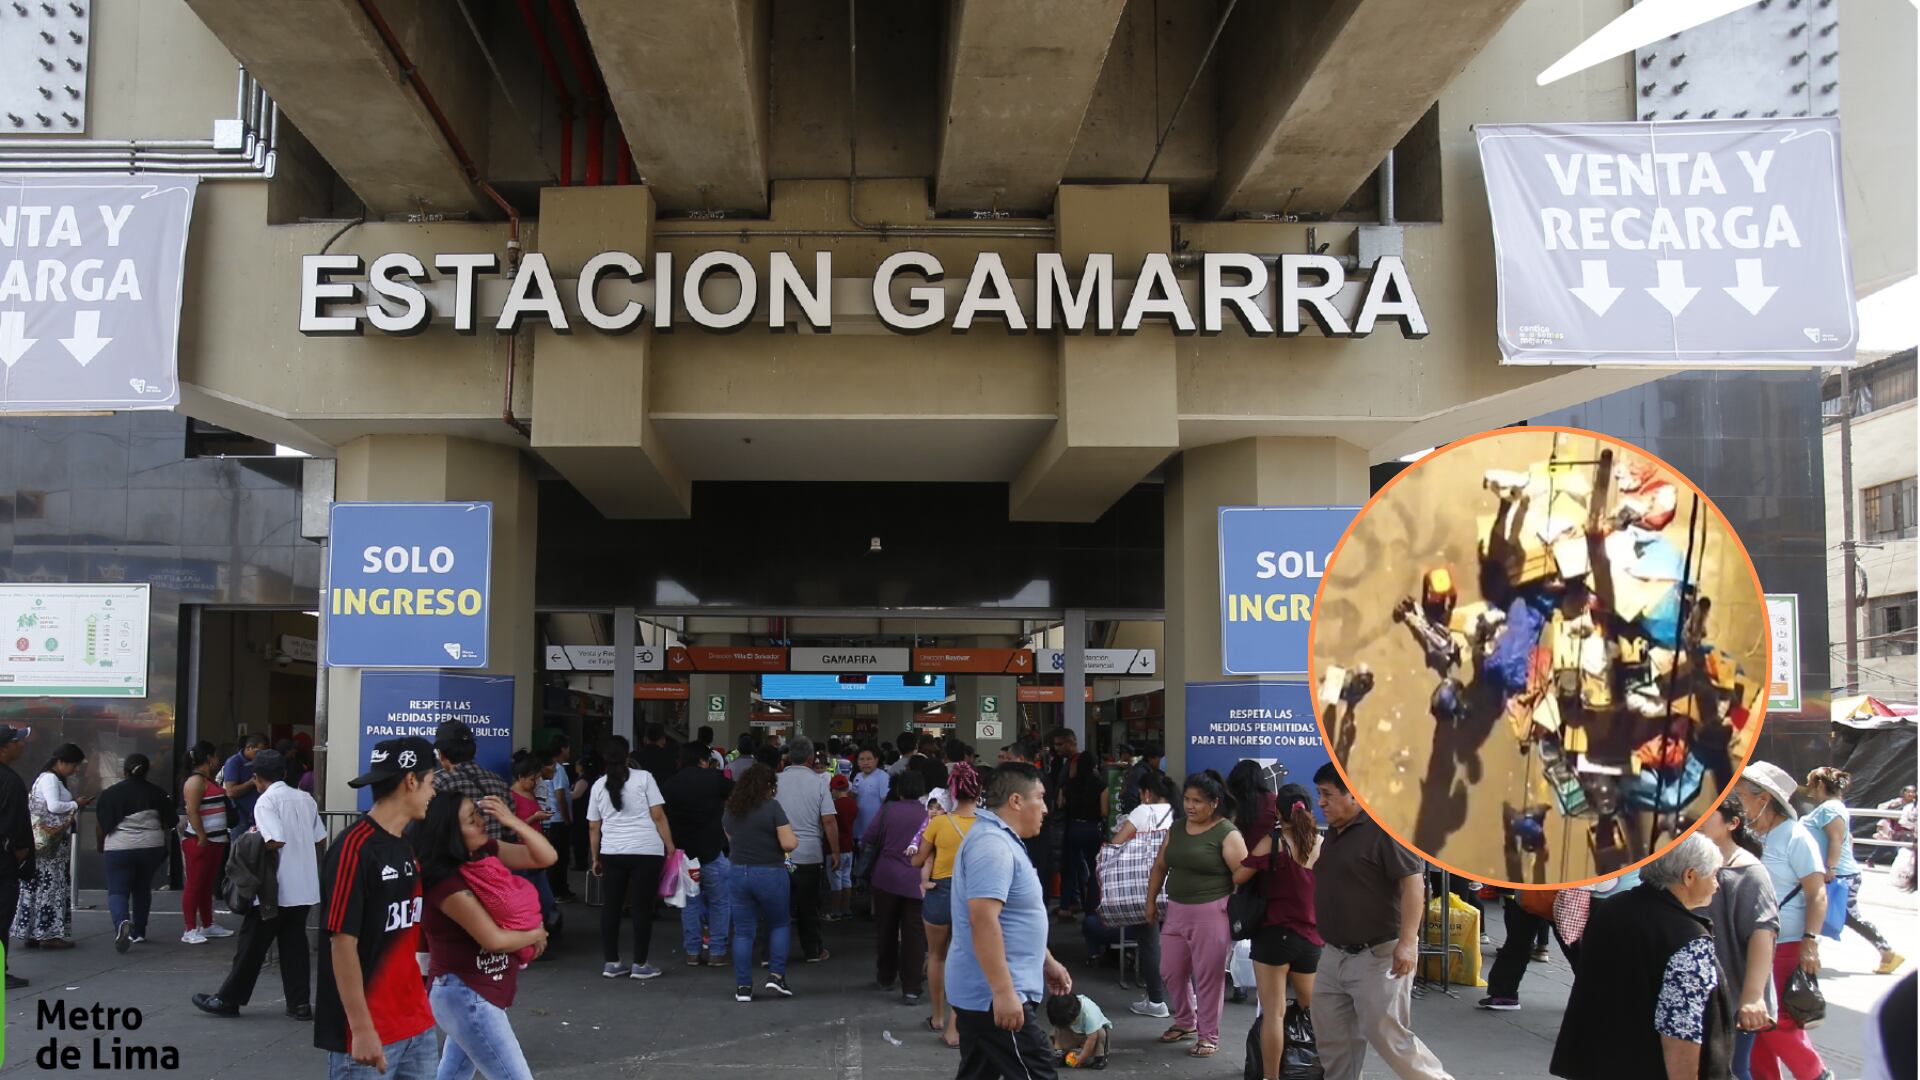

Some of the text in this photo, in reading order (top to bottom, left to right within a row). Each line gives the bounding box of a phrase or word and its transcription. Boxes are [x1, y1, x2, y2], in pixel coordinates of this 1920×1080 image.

[1544, 150, 1775, 196] VENTA Y
[99, 205, 135, 247] Y
[1540, 204, 1801, 251] RECARGA
[299, 250, 1431, 338] ESTACION GAMARRA
[362, 545, 455, 574] SOLO
[332, 588, 483, 617] INGRESO
[1228, 593, 1317, 622] INGR
[821, 655, 878, 665] GAMARRA
[410, 700, 471, 711] RESPETA LAS
[711, 696, 723, 711] S
[983, 697, 995, 712] S
[387, 713, 433, 722] MEDIDAS
[1229, 709, 1292, 719] RESPETA LAS
[366, 725, 393, 735] PARA
[395, 726, 406, 736] EL
[408, 726, 438, 736] INGRE
[475, 727, 510, 737] BULTOS
[1210, 722, 1315, 733] MEDIDAS PERMITIDAS
[1191, 735, 1323, 746] PARA EL INGRESO CON BULT
